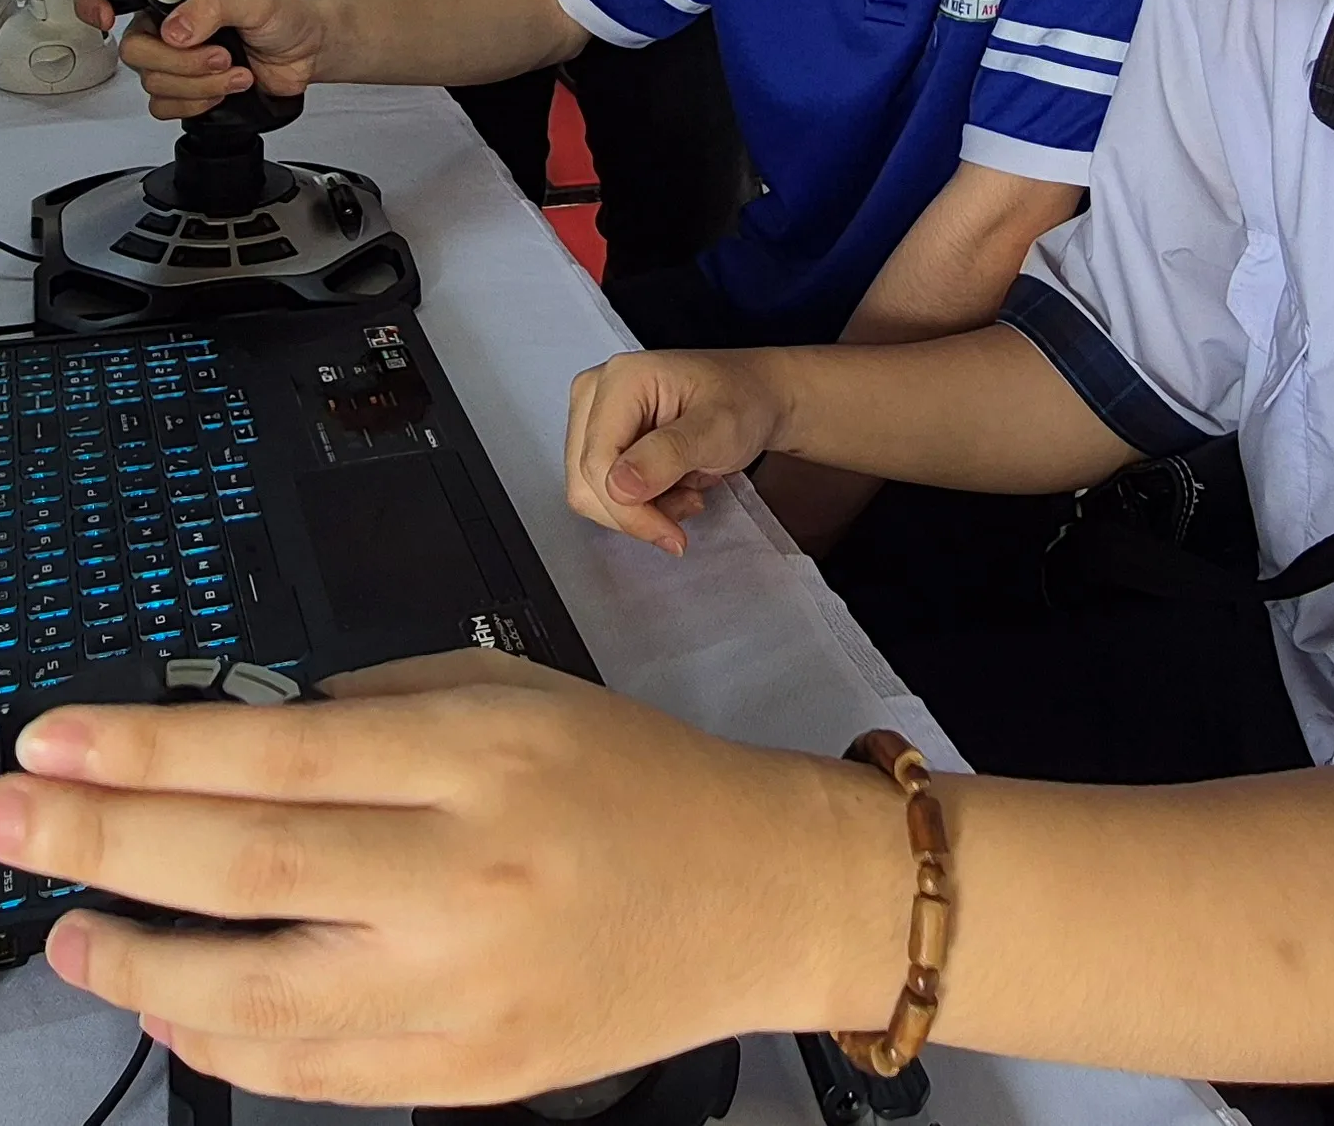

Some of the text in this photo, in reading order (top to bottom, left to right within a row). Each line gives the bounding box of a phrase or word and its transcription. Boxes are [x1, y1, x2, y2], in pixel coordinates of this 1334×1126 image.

[87, 489, 97, 497] P
[138, 501, 148, 509] L
[141, 527, 152, 536] K
[192, 532, 204, 542] M
[198, 560, 210, 570] N
[95, 570, 106, 580] U
[150, 583, 162, 594] H
[204, 590, 216, 600] B
[43, 596, 56, 605] 7
[98, 601, 110, 611] Y
[154, 614, 166, 625] G
[45, 626, 57, 636] 6
[210, 622, 222, 632] V
[101, 634, 114, 644] T
[158, 649, 171, 658] F
[47, 660, 60, 671] 5
[3, 870, 13, 893] ESC
